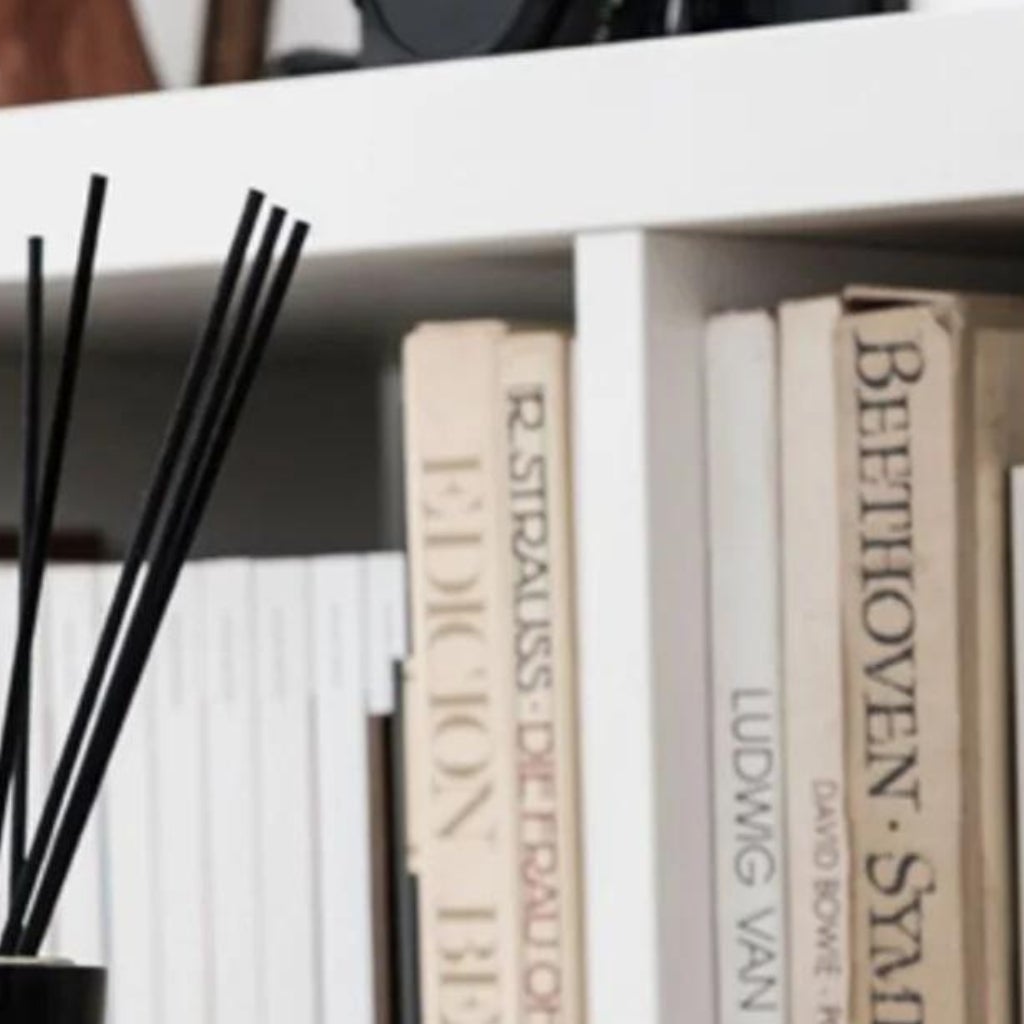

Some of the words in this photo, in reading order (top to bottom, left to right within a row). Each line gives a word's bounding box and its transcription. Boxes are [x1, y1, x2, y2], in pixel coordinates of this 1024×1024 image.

[510, 451, 554, 692] STRAUSS
[855, 328, 925, 812] BEETHOVEN
[731, 687, 775, 888] LUDWIG
[812, 778, 840, 870] DAVID
[520, 811, 561, 948] FRAU
[814, 880, 842, 977] BOWIE
[736, 905, 777, 1012] VAN
